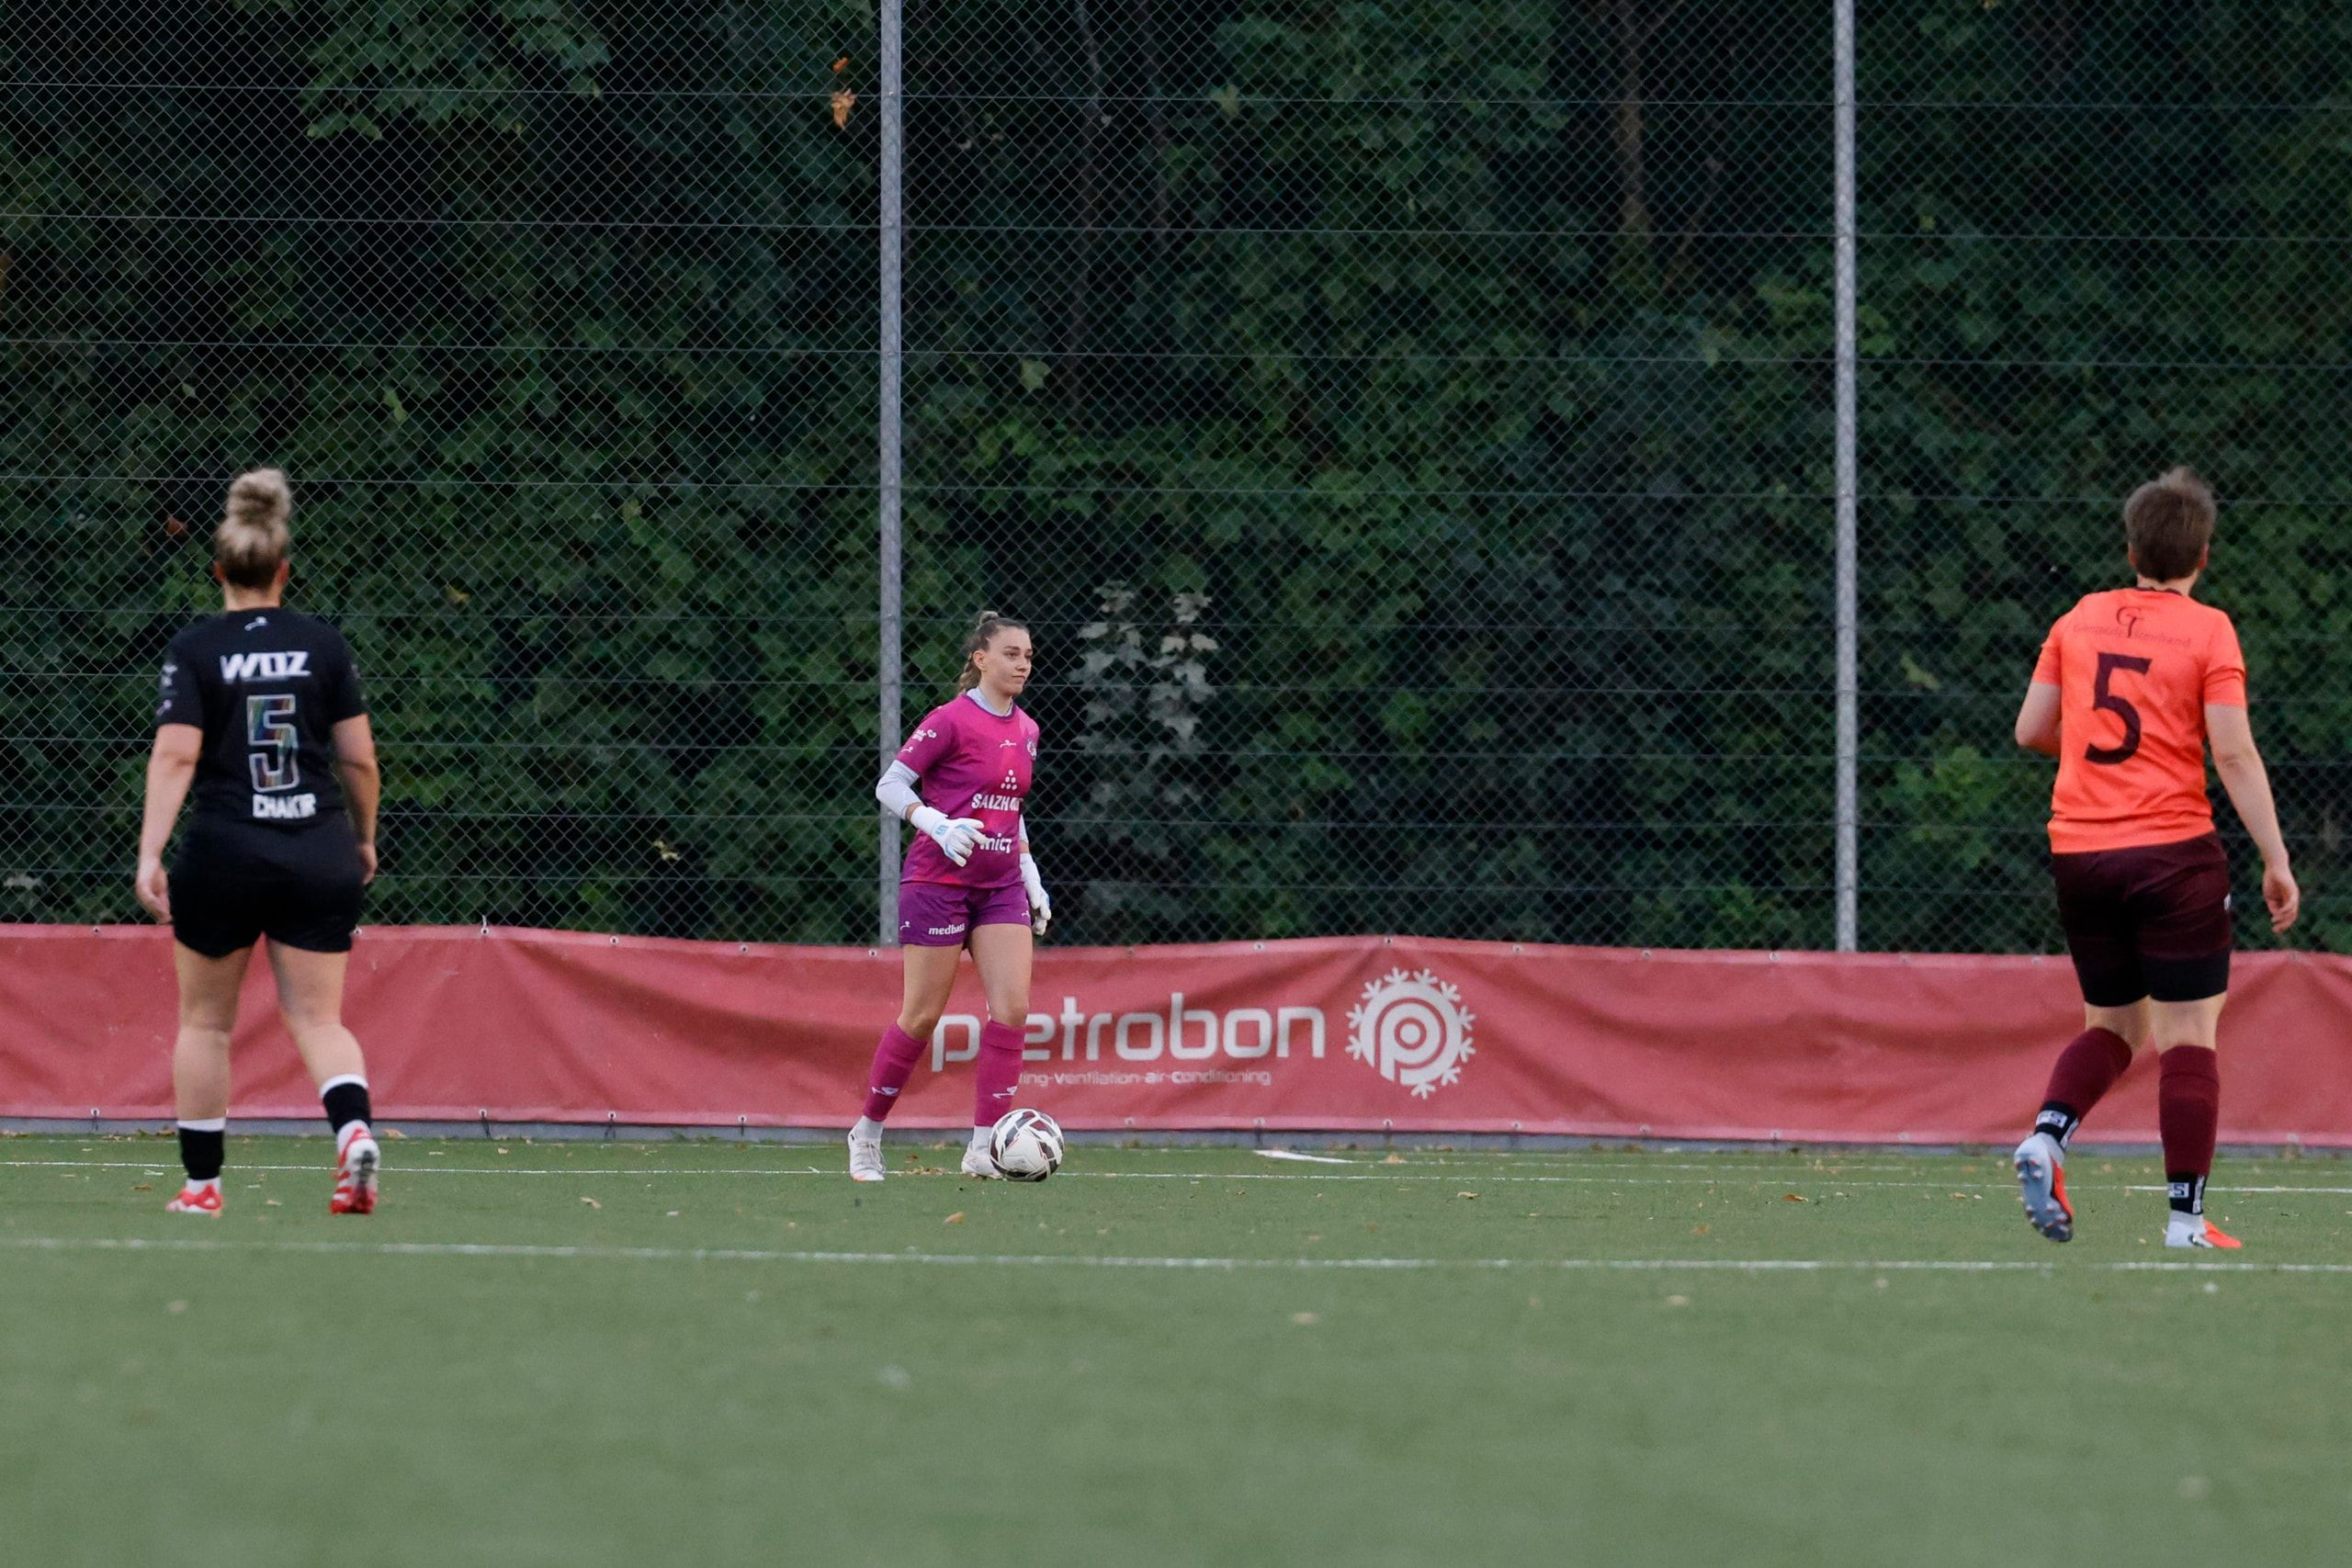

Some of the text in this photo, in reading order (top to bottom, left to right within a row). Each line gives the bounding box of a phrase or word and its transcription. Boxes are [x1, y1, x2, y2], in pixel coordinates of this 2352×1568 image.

[220, 650, 311, 684] WOZ
[2085, 652, 2153, 764] 5
[246, 694, 300, 793] 5
[931, 992, 1326, 1072] petrobon
